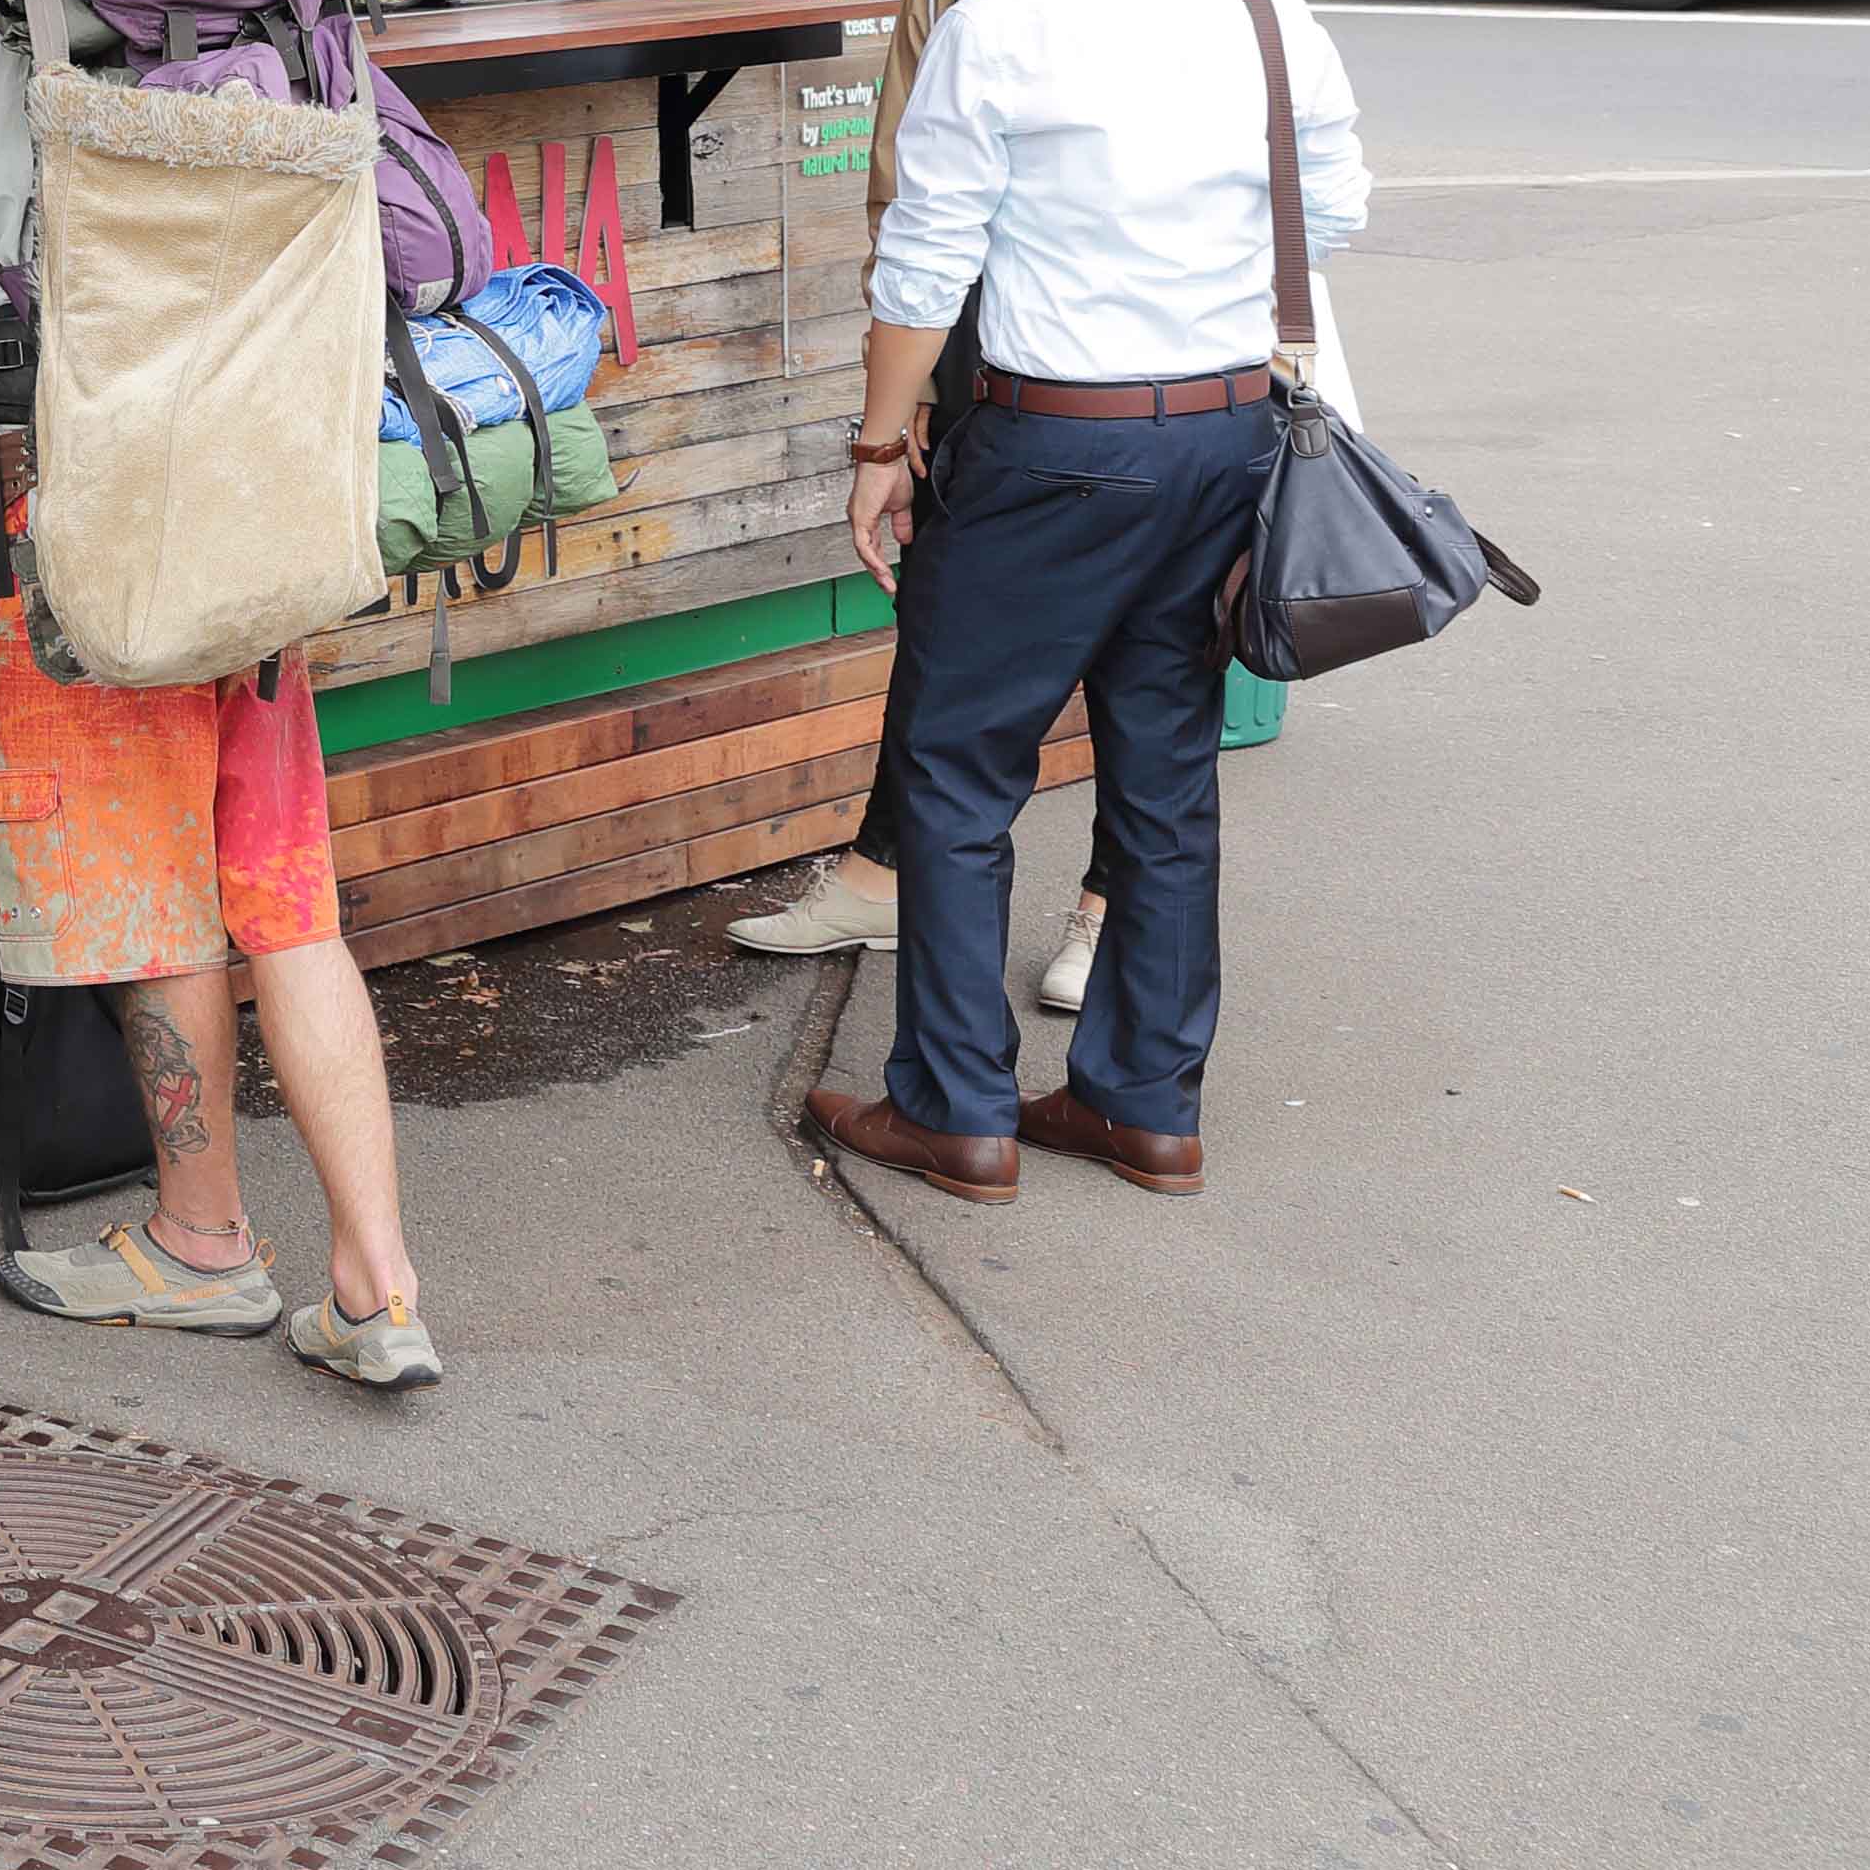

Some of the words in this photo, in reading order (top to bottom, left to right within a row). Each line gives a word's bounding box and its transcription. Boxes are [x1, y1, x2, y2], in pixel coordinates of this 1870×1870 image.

[801, 83, 845, 110] That's
[846, 81, 874, 107] why
[802, 121, 821, 147] by
[803, 145, 849, 178] natural
